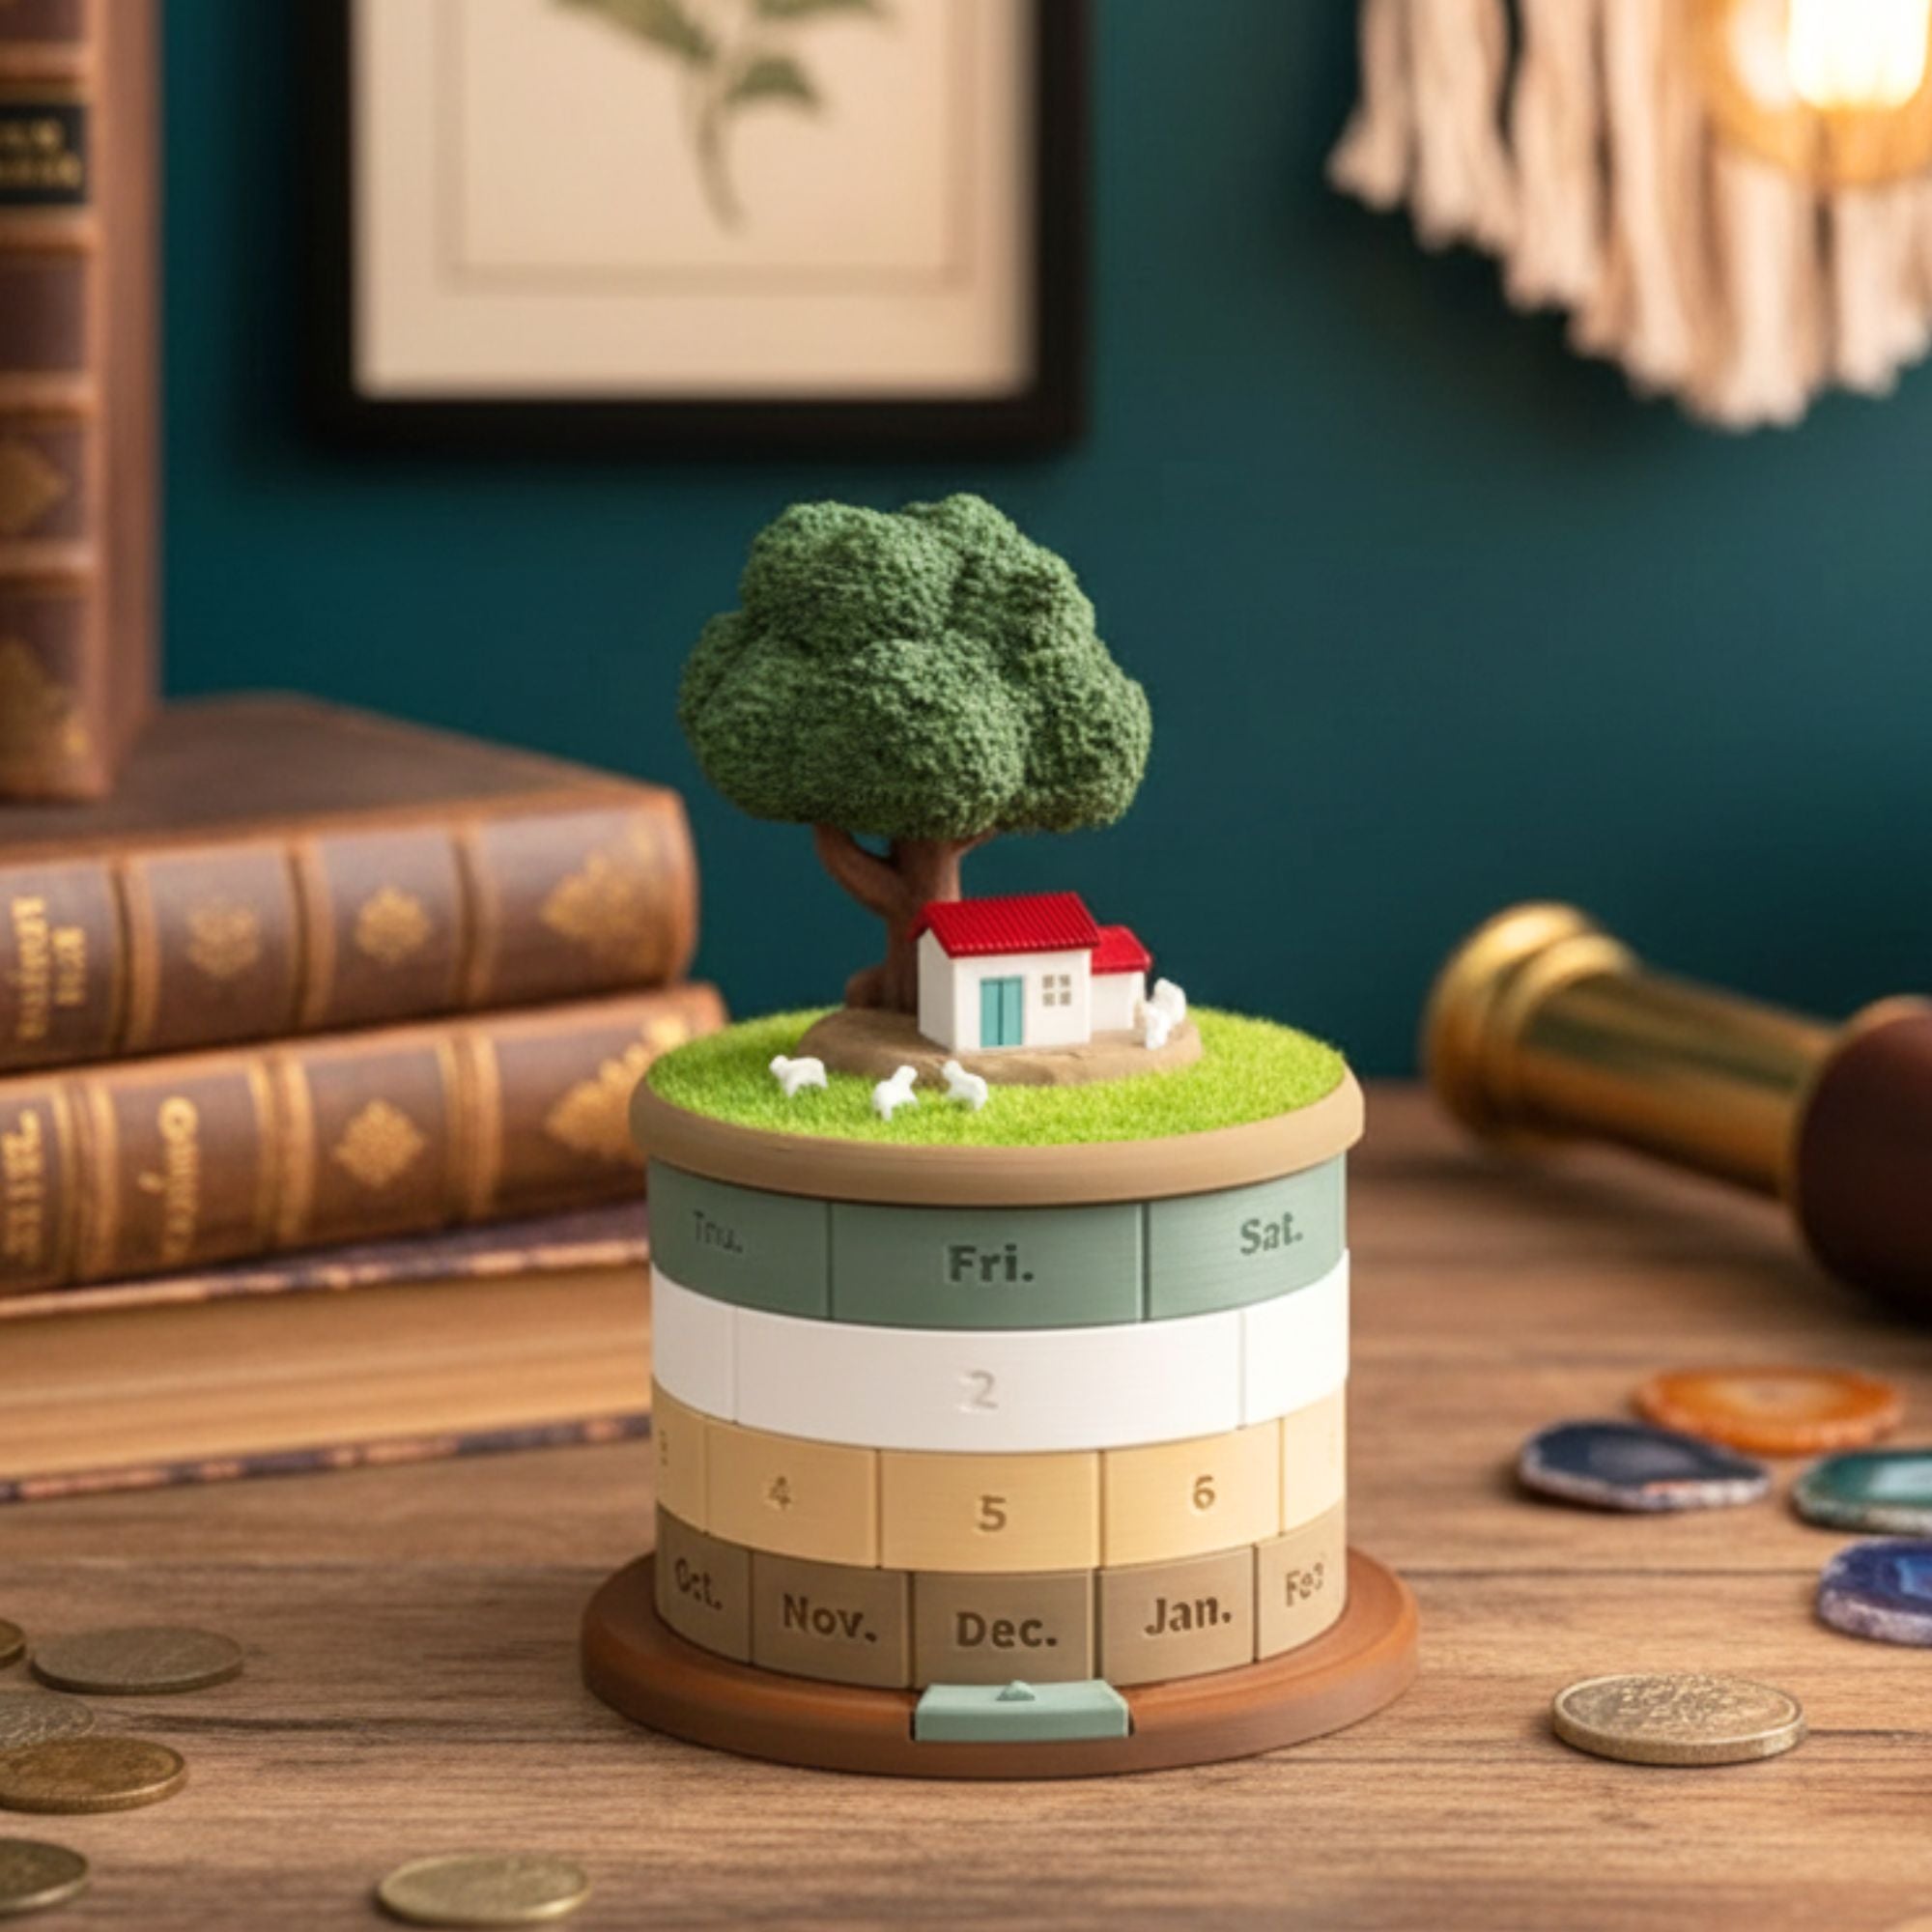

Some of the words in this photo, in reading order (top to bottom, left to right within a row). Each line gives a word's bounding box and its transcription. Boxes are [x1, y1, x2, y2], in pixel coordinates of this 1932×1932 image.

[948, 1244, 1034, 1283] Fri.
[1239, 1211, 1304, 1256] Sat.
[968, 1370, 999, 1409] 2
[979, 1495, 1009, 1532] 5
[1193, 1475, 1216, 1510] 6
[782, 1594, 877, 1642] Nov.
[955, 1611, 1059, 1648] Dec.
[1144, 1597, 1233, 1636] Jan.
